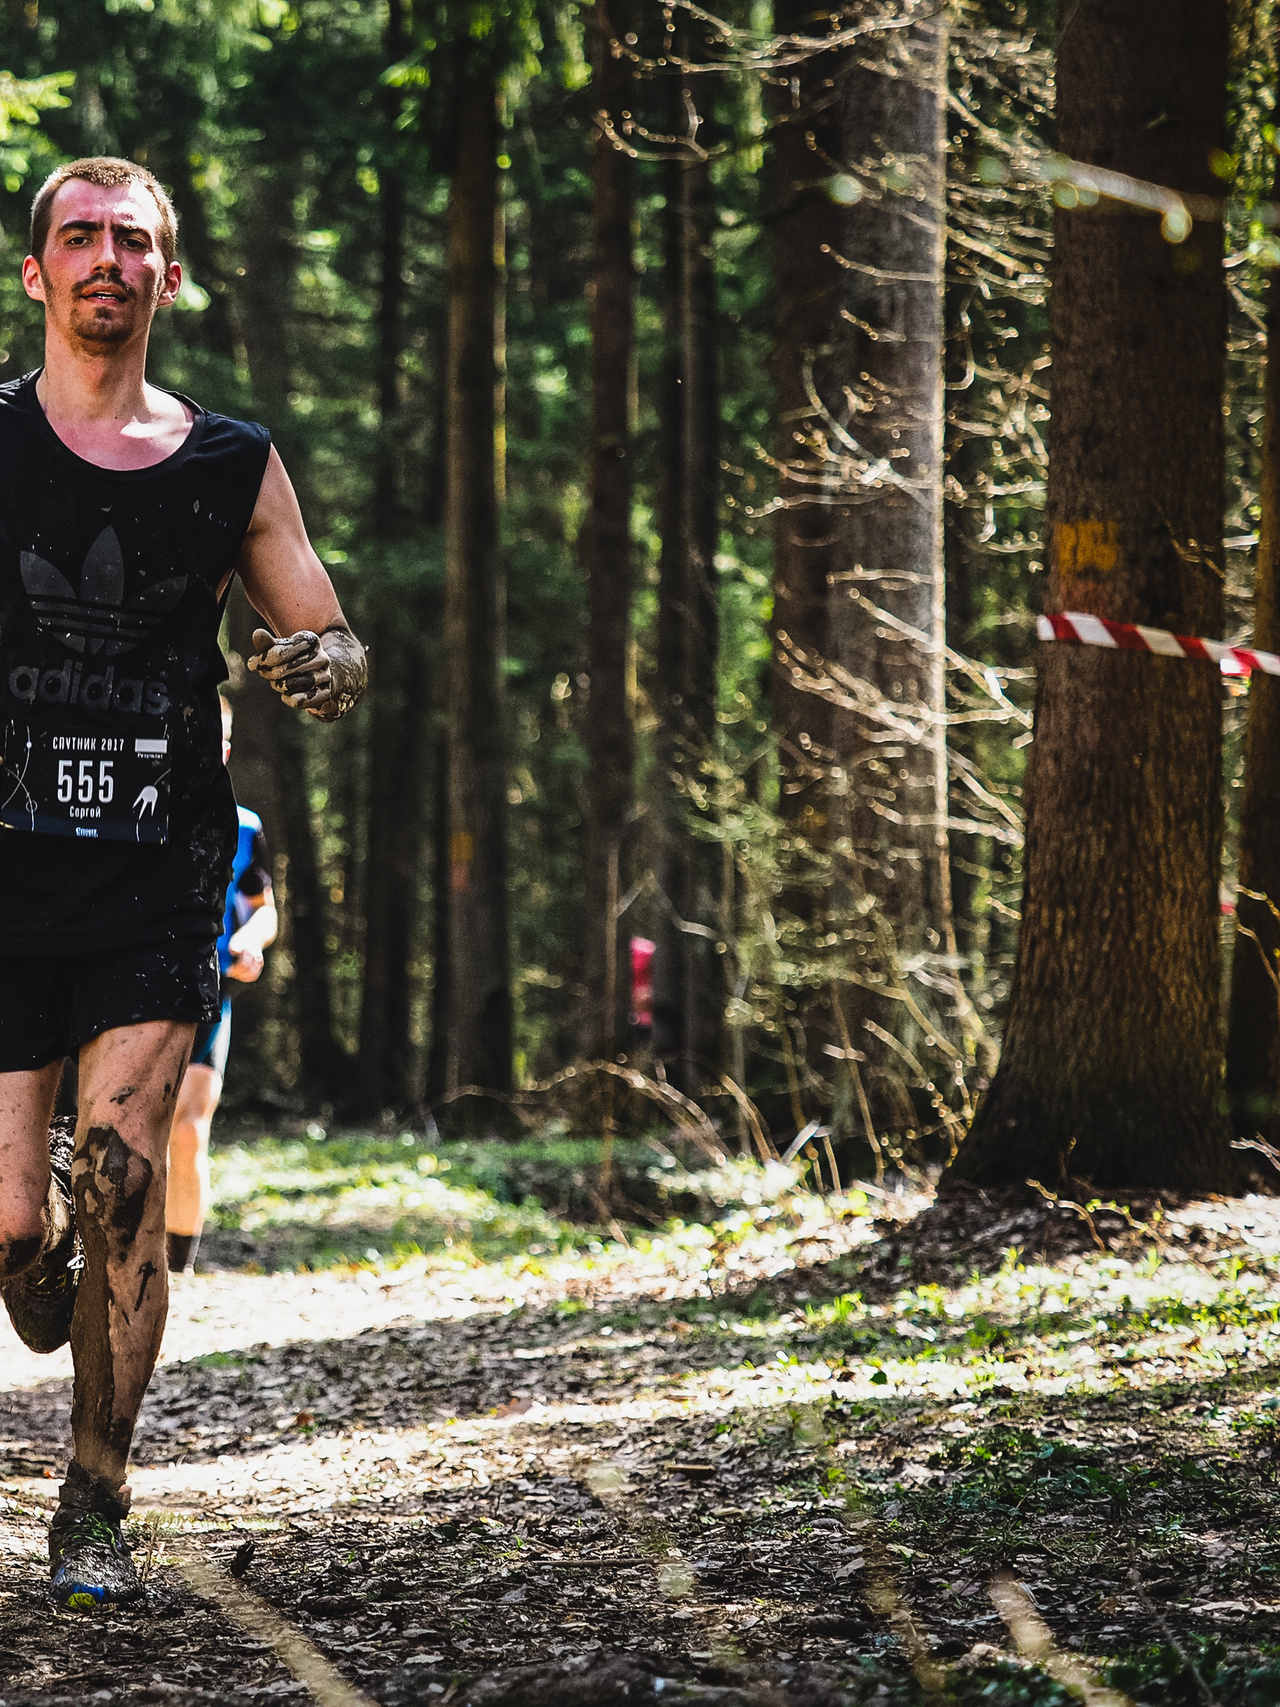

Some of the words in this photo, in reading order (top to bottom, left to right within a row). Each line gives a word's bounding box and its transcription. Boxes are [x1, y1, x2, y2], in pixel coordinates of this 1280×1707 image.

[9, 659, 169, 715] adidas
[52, 736, 97, 751] СПУТНИК
[101, 738, 124, 752] 2017
[57, 759, 114, 803] 555
